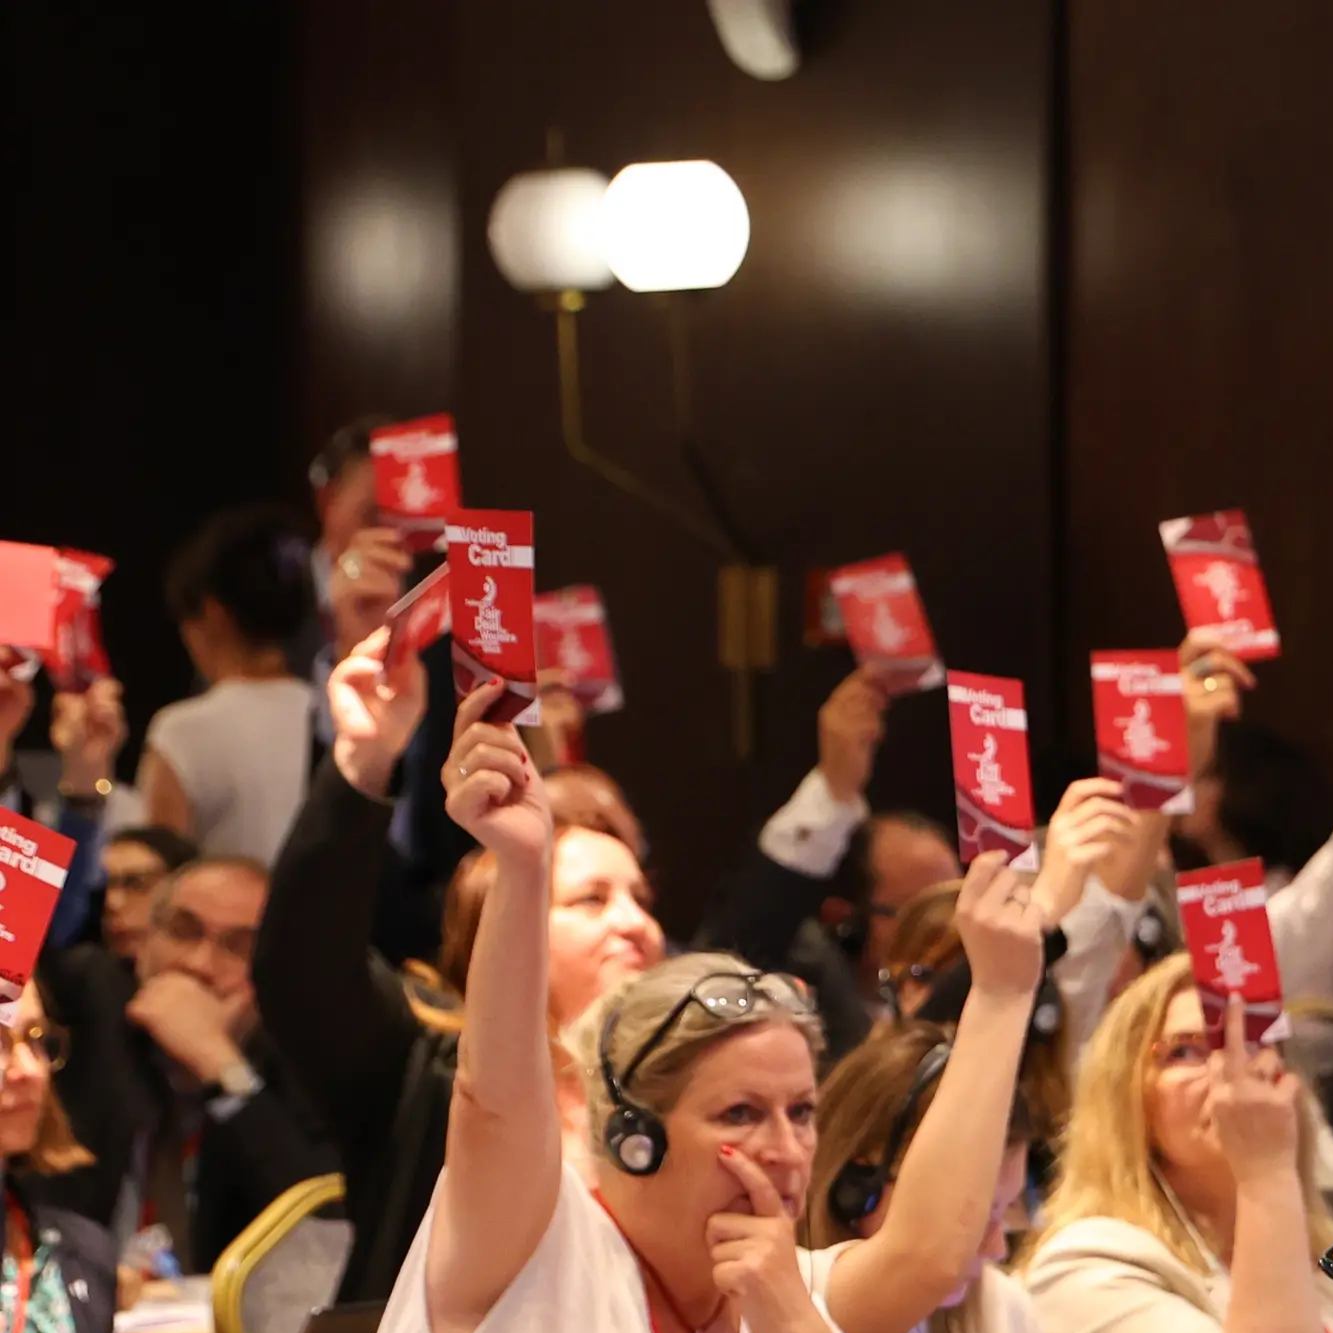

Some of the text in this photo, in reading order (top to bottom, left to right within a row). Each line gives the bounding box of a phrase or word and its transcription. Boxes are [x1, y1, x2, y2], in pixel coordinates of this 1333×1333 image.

[461, 526, 507, 548] Voting
[468, 543, 511, 567] Card
[970, 703, 1008, 727] Card
